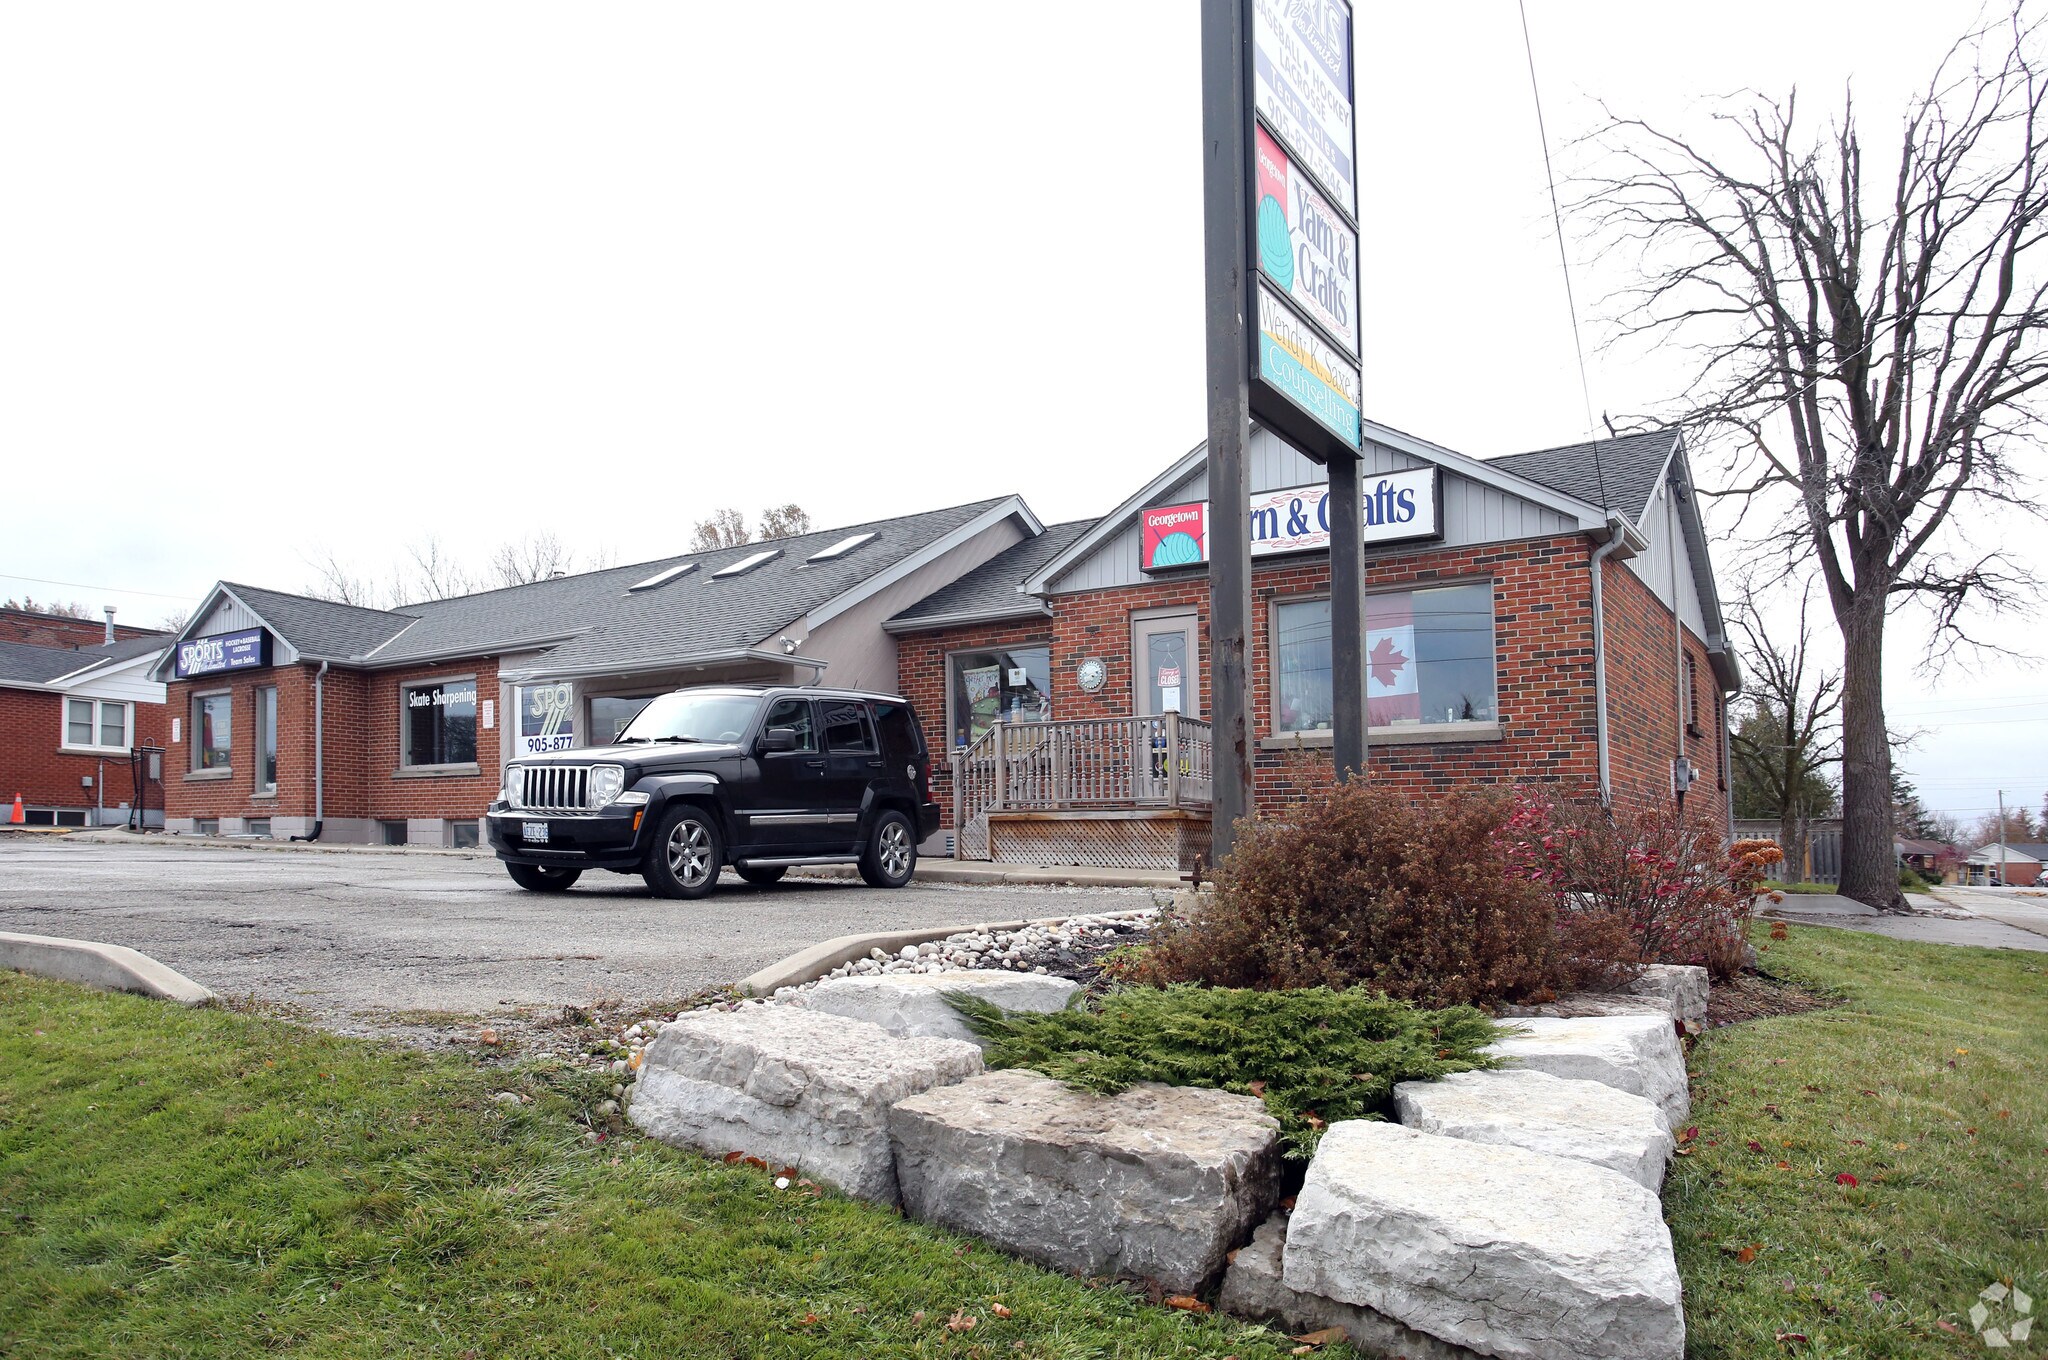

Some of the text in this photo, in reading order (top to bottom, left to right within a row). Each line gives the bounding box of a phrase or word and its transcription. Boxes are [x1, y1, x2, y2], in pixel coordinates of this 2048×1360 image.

[1269, 64, 1337, 164] Team Sales
[1279, 46, 1327, 123] LACROSSE
[1312, 68, 1350, 128] HOCKEY
[1267, 95, 1343, 202] 905-877-5546
[1294, 177, 1351, 282] Yarn &
[1299, 242, 1348, 328] Crafts
[1259, 290, 1307, 371] Wendy
[1309, 335, 1324, 377] K.
[1269, 345, 1354, 440] Counselling
[1148, 510, 1199, 528] Georgetown
[1250, 506, 1280, 541] rn
[1286, 497, 1311, 537] &
[180, 641, 225, 670] SPORTS
[225, 638, 241, 647] HOCKEY
[230, 655, 256, 666] Team Sales
[409, 687, 477, 709] Skate Sharpening
